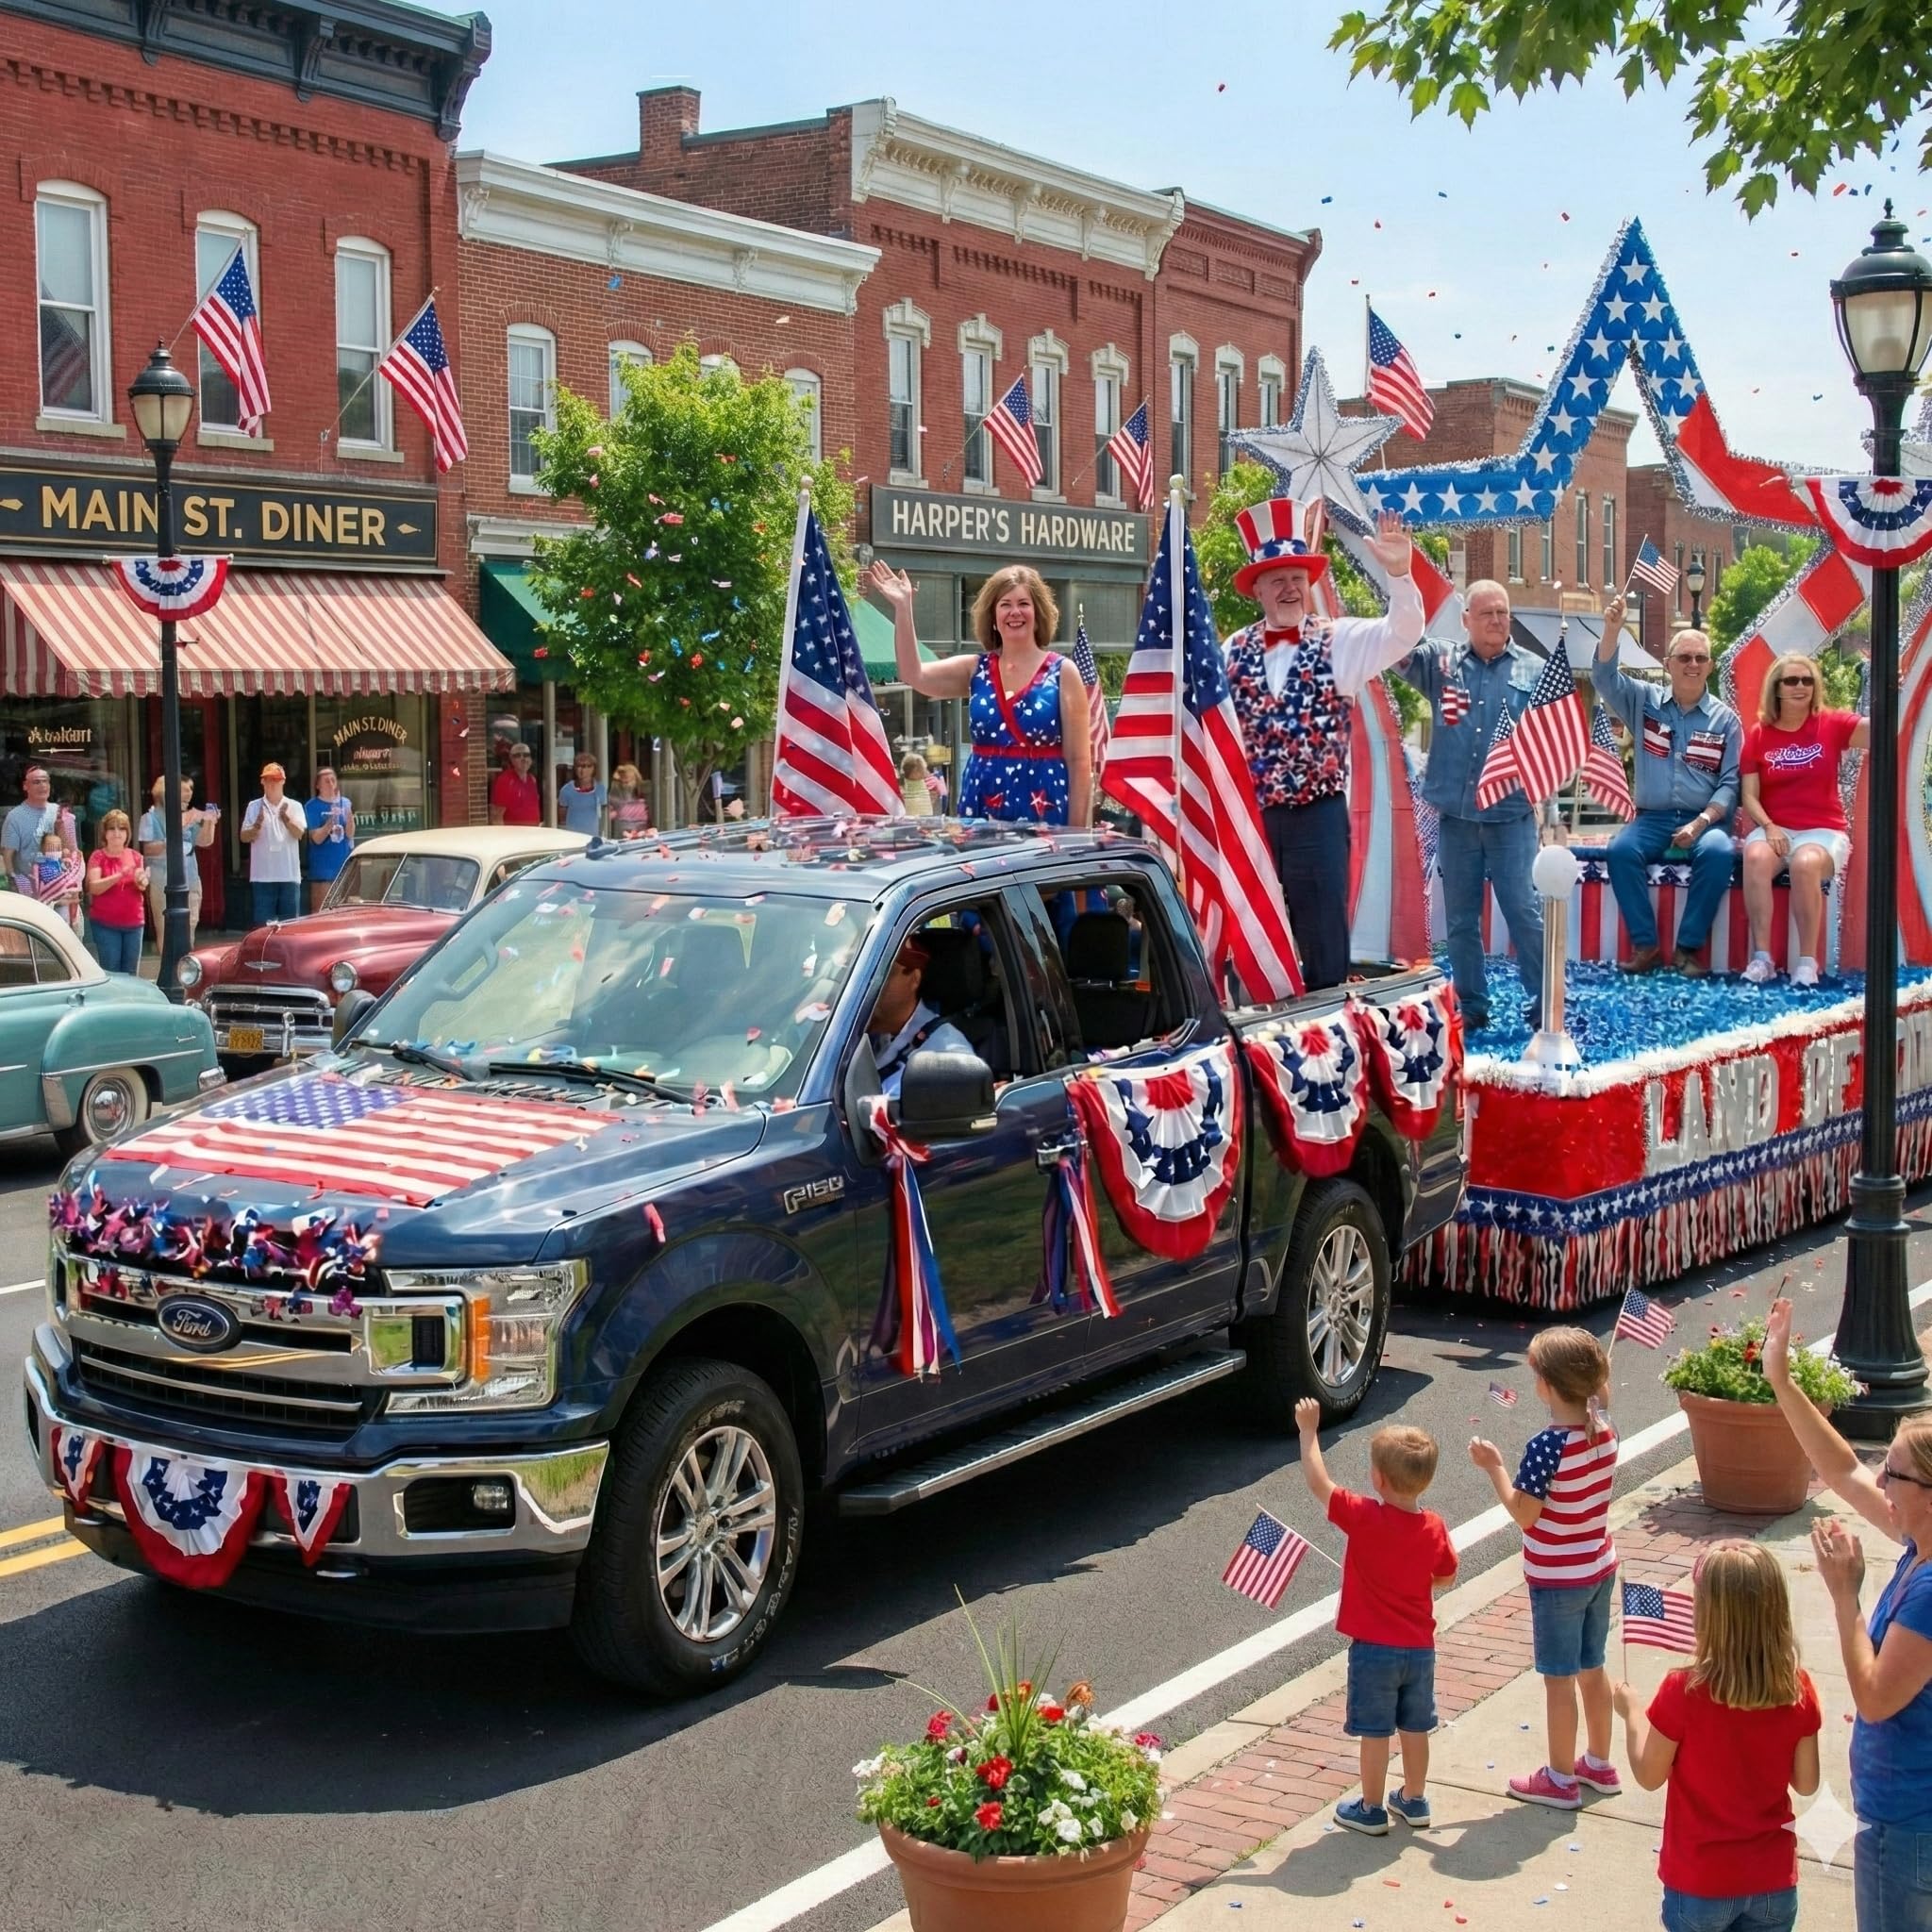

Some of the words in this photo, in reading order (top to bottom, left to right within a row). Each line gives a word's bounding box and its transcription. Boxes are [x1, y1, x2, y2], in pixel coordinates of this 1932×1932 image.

[42, 486, 158, 534] MAIN
[183, 495, 242, 538] ST.
[261, 501, 385, 546] DINER
[892, 499, 1009, 543] HARPER'S
[1021, 512, 1135, 553] HARDWARE
[333, 720, 360, 747] MAIN
[377, 717, 408, 744] DINER
[1644, 1053, 1778, 1176] LAND
[173, 1308, 211, 1337] Ford
